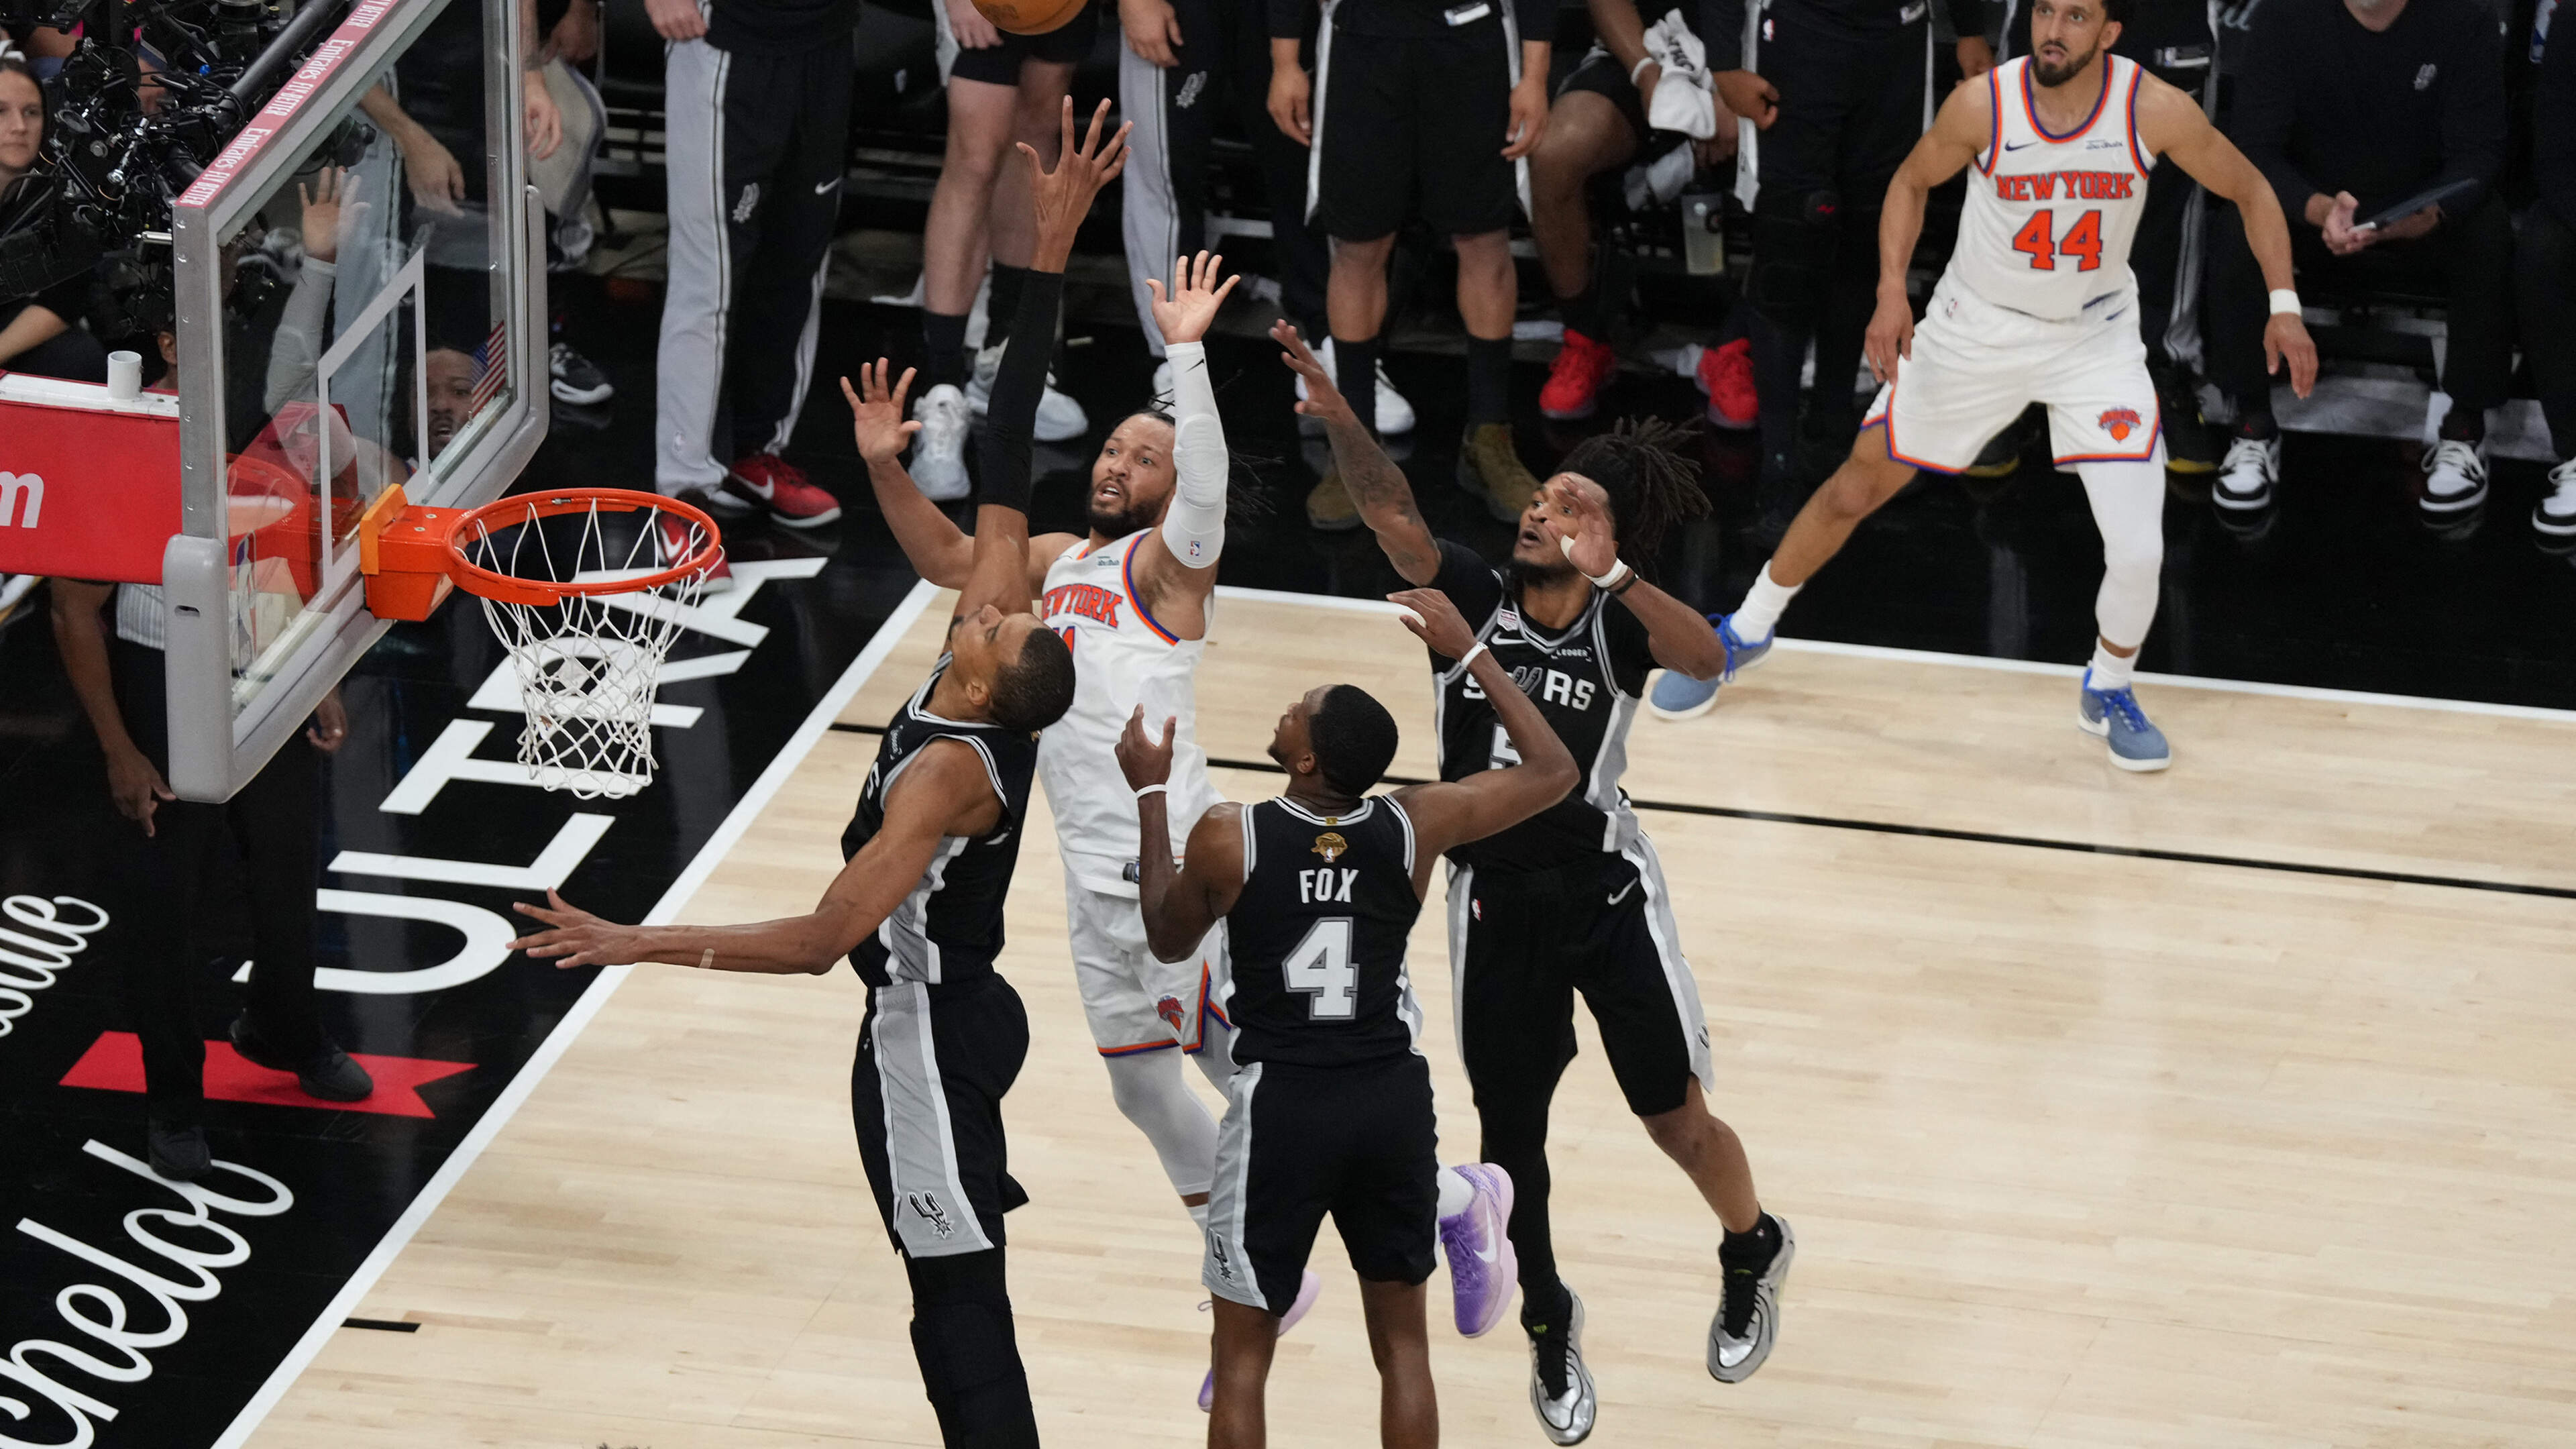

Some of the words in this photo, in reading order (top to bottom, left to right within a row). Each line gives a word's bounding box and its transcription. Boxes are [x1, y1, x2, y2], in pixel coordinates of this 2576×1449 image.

[346, 5, 385, 28] BETTER
[298, 39, 355, 80] Emirates
[264, 93, 303, 116] BETTER
[286, 81, 314, 94] FLY
[215, 127, 272, 168] Emirates
[180, 182, 220, 205] BETTER
[202, 170, 231, 183] FLY
[1995, 171, 2058, 201] NEW
[2059, 170, 2135, 199] YORK
[2012, 209, 2102, 272] 44
[1042, 585, 1072, 622] EW
[1065, 583, 1124, 629] YORK
[1556, 648, 1588, 657] LEDGER
[231, 556, 827, 994] ULTRA
[1299, 867, 1359, 904] FOX
[1281, 916, 1360, 1020] 4
